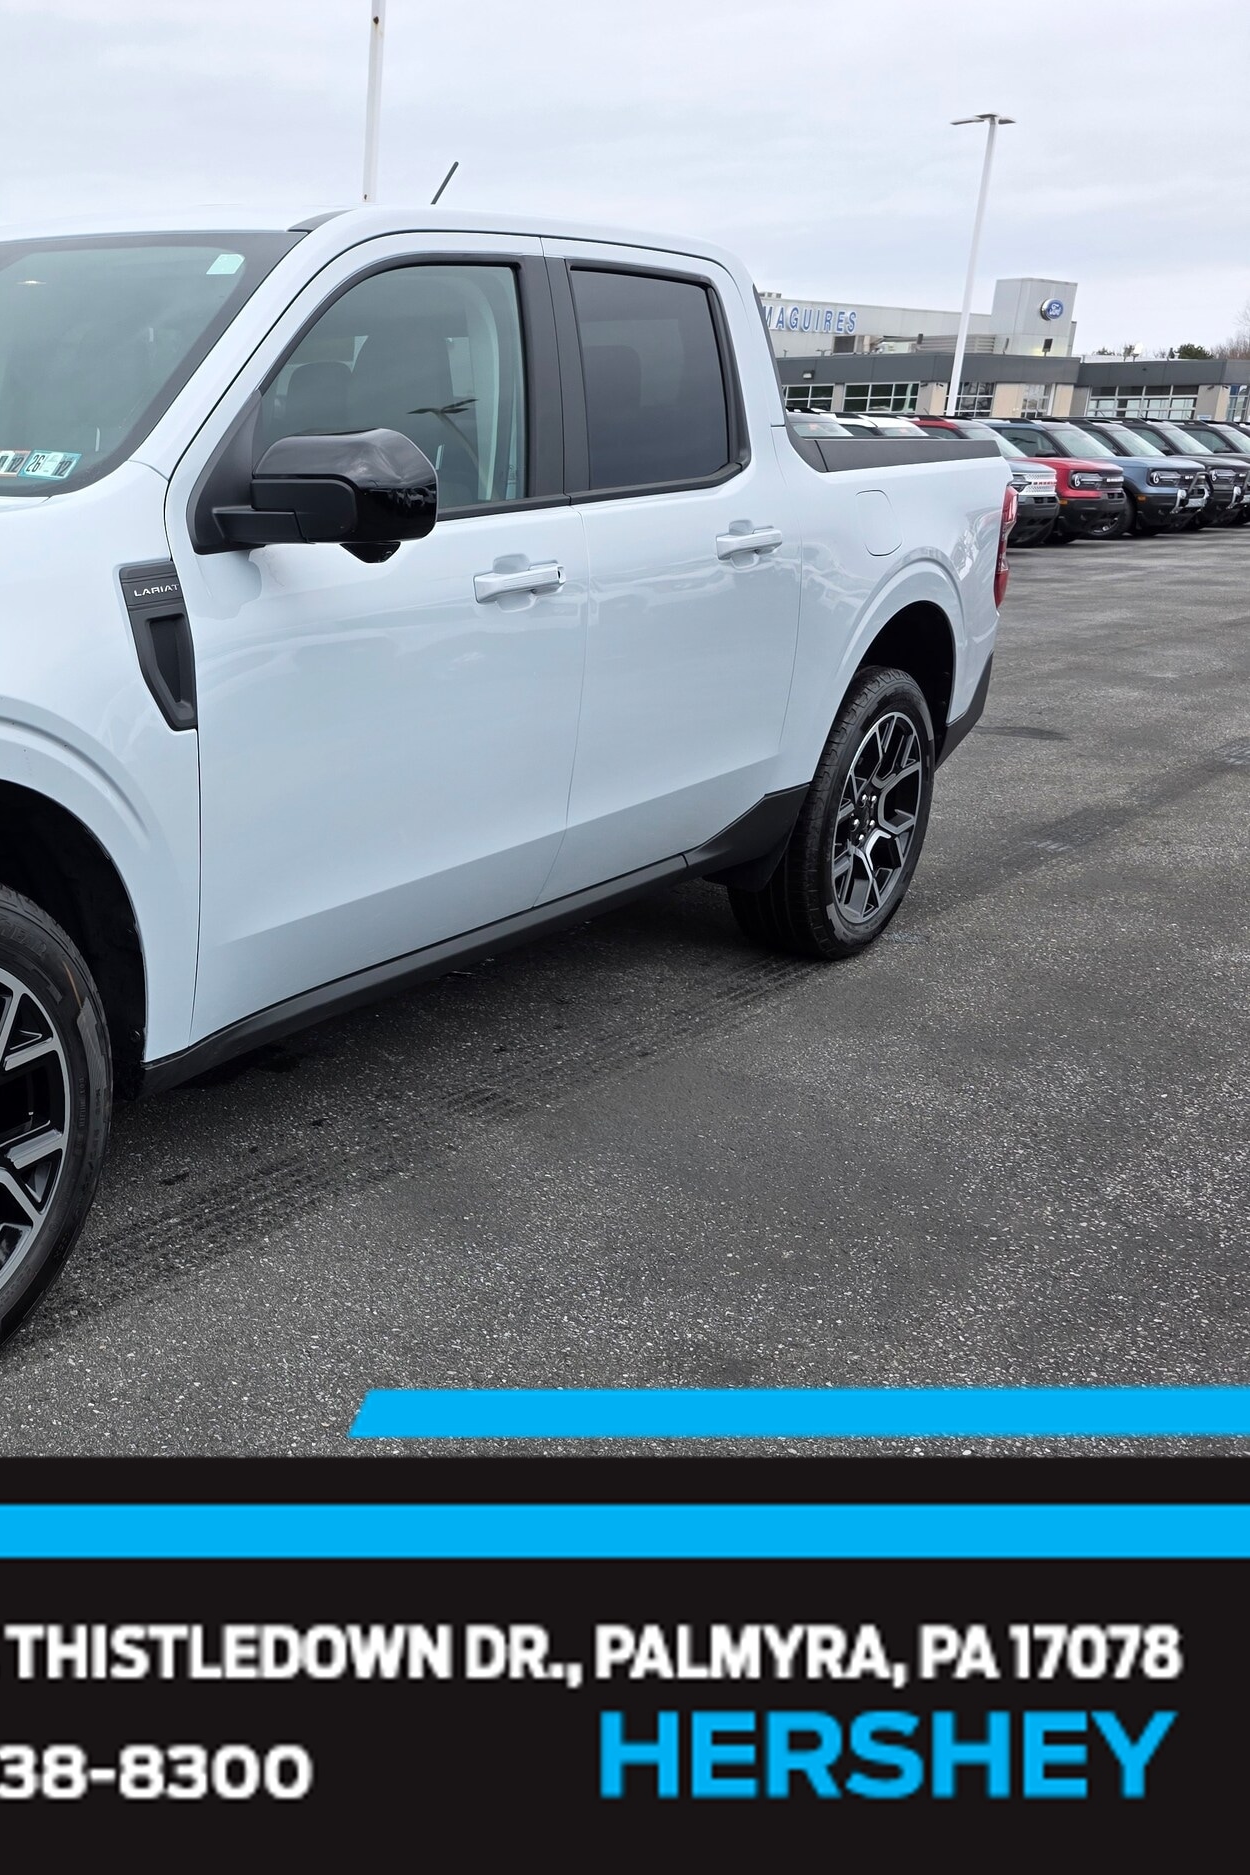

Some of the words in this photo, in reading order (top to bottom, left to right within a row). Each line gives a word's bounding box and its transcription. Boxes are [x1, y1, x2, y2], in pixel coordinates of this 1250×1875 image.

[762, 305, 857, 333] MAGUIRES
[25, 454, 46, 473] 26
[53, 460, 72, 477] 12
[133, 583, 180, 597] LARIAT
